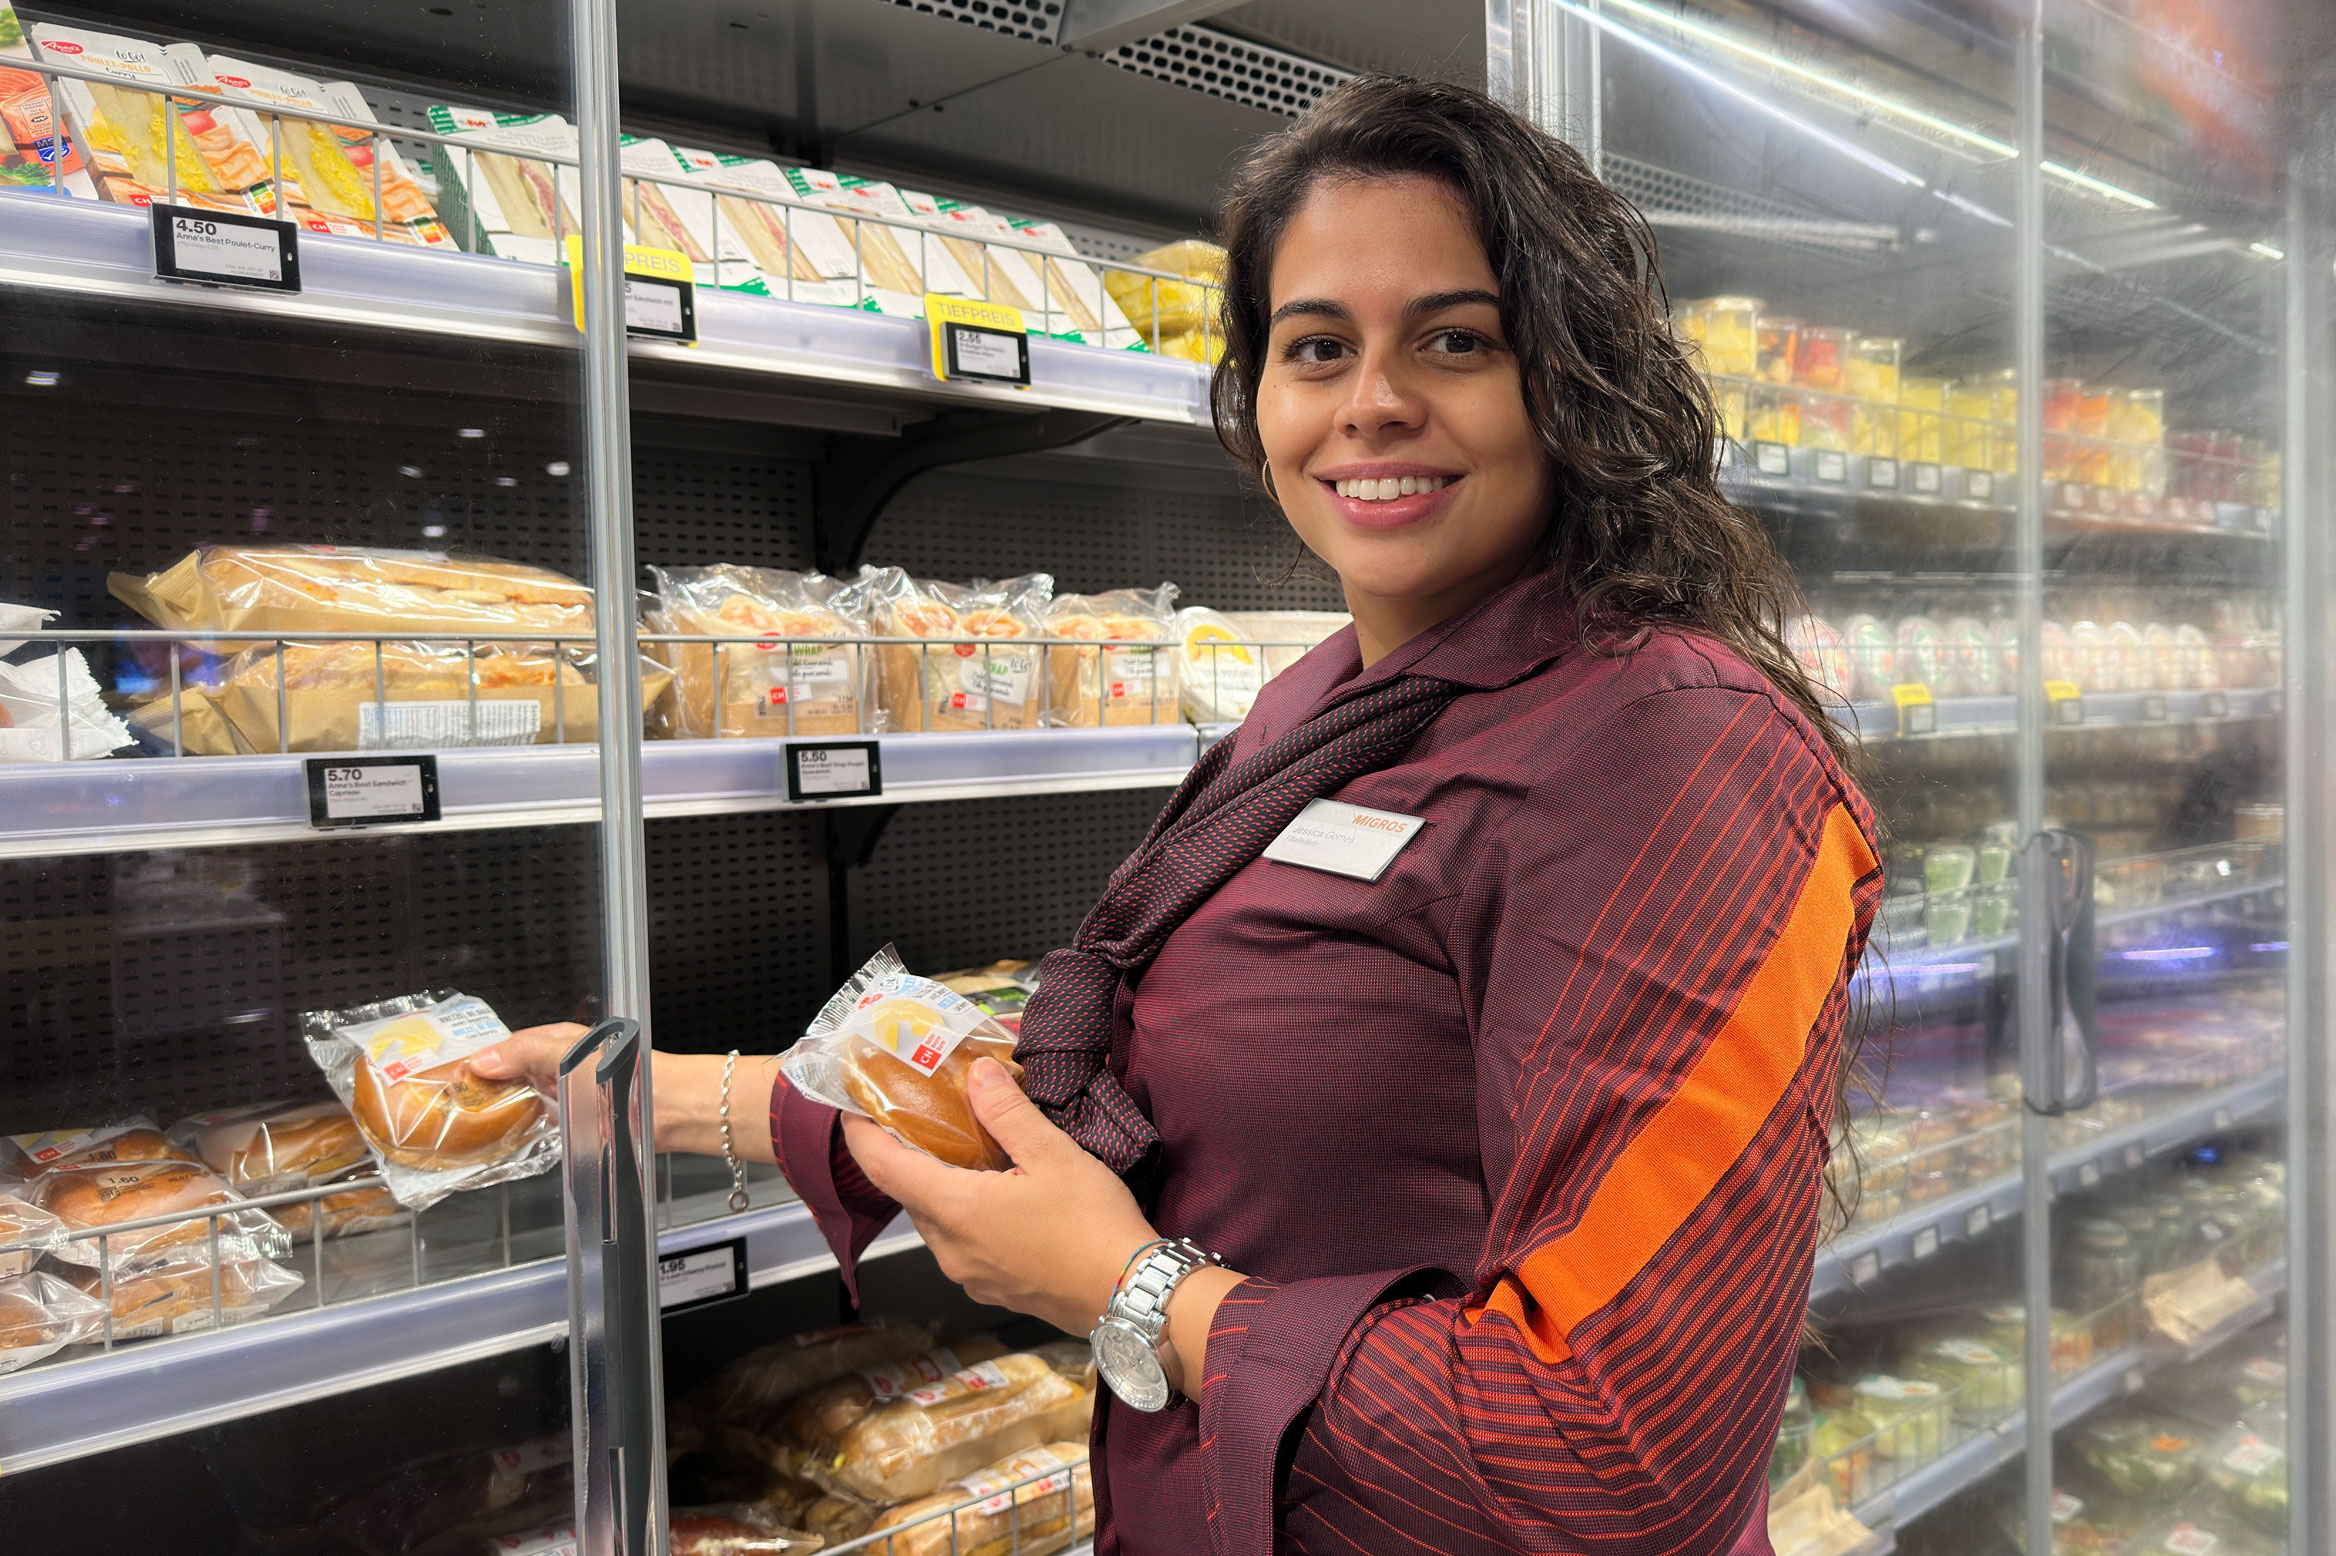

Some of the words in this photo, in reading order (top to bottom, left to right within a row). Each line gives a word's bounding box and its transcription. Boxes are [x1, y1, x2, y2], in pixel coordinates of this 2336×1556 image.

[176, 219, 217, 235] 4.50
[176, 232, 204, 242] Anna's
[205, 236, 224, 245] Best
[225, 238, 275, 253] Poulet-Curry
[624, 252, 681, 273] PREIS
[936, 303, 1015, 326] TIEFPREIS
[793, 645, 823, 656] WRAP
[801, 751, 827, 761] 5.50
[328, 769, 362, 781] 5.70
[372, 779, 407, 787] Sandwich
[328, 789, 359, 797] Caprese
[1352, 814, 1407, 833] MIGROS
[1292, 825, 1325, 838] Jessica
[1325, 830, 1355, 844] Gomes
[920, 1050, 933, 1063] CH
